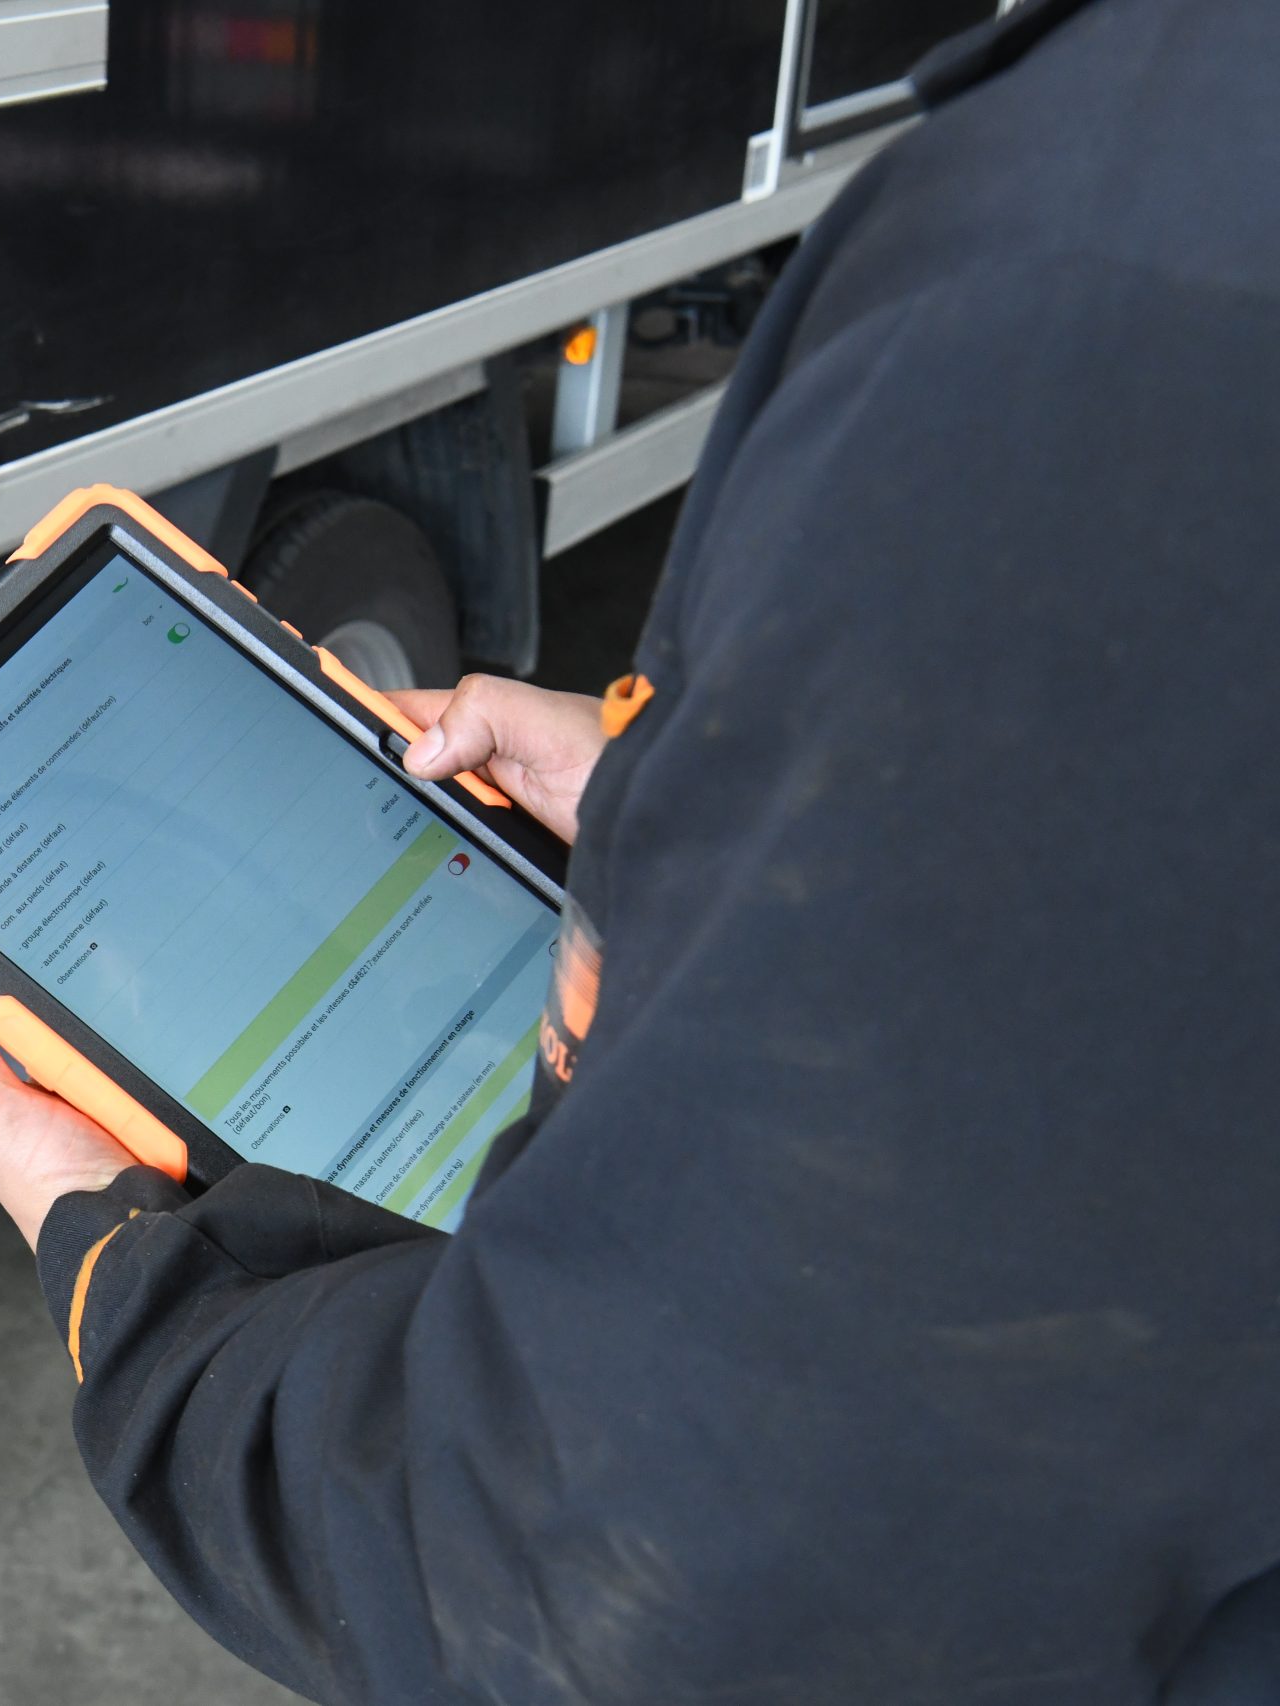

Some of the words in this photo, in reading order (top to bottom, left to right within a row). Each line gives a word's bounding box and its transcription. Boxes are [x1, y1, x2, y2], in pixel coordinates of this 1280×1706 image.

[13, 687, 42, 715] sécurités
[10, 773, 39, 801] éléments
[45, 730, 82, 767] commandes
[78, 695, 117, 733] (défaut/bon)
[380, 793, 400, 814] défaut
[1, 822, 29, 849] (défaut)
[16, 847, 43, 874] distance
[39, 823, 67, 850] (défaut)
[26, 884, 45, 904] pieds
[41, 860, 69, 887] (défaut)
[21, 925, 44, 950] groupe
[79, 860, 106, 887] (défaut)
[81, 898, 109, 926] (défaut)
[56, 949, 93, 985] Observations
[249, 1060, 287, 1102] mouvements
[284, 1030, 313, 1063] possibles
[325, 988, 351, 1015] vitesses
[336, 1131, 372, 1172] dynamiques
[375, 1096, 401, 1126] mesures
[404, 1039, 450, 1089] fonctionnement
[454, 1010, 475, 1033] charge
[232, 1092, 272, 1136] (défaut/bon)
[250, 1112, 286, 1150] Observations
[375, 1181, 395, 1202] Centre
[427, 1120, 446, 1141] charge
[456, 1084, 477, 1107] plateau
[352, 1165, 377, 1193] masses
[419, 1179, 447, 1211] dynamique
